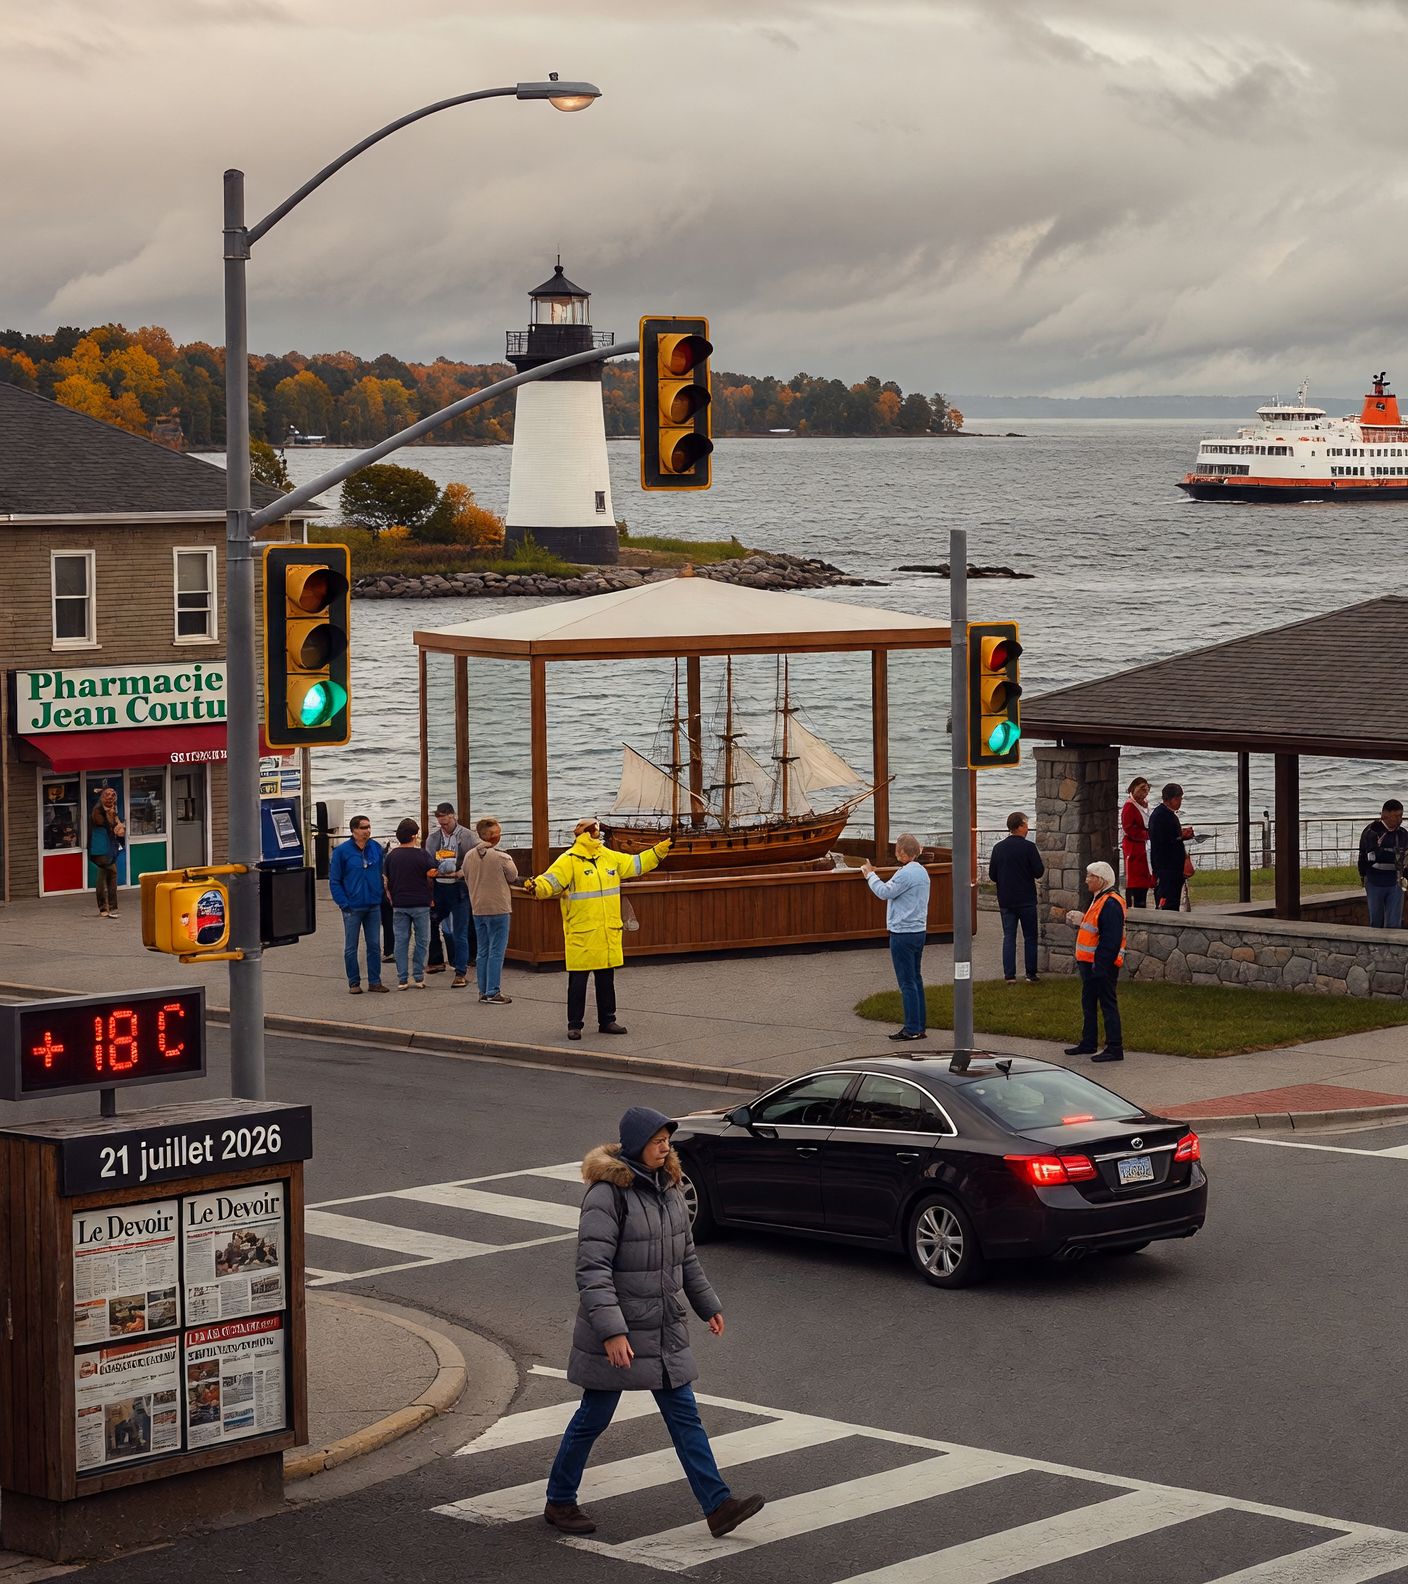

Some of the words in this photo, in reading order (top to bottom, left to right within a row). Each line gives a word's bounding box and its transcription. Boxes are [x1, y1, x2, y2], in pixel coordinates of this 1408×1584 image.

[27, 665, 224, 701] Pharmacie
[31, 701, 118, 729] Jean
[95, 1008, 138, 1072] 18
[158, 1003, 185, 1057] C
[100, 1145, 128, 1178] 21
[139, 1134, 214, 1182] juillet
[221, 1124, 282, 1160] 2026
[187, 1201, 213, 1226] Le
[216, 1192, 280, 1220] Devoir
[78, 1220, 103, 1244] Le
[107, 1210, 173, 1240] Devoir
